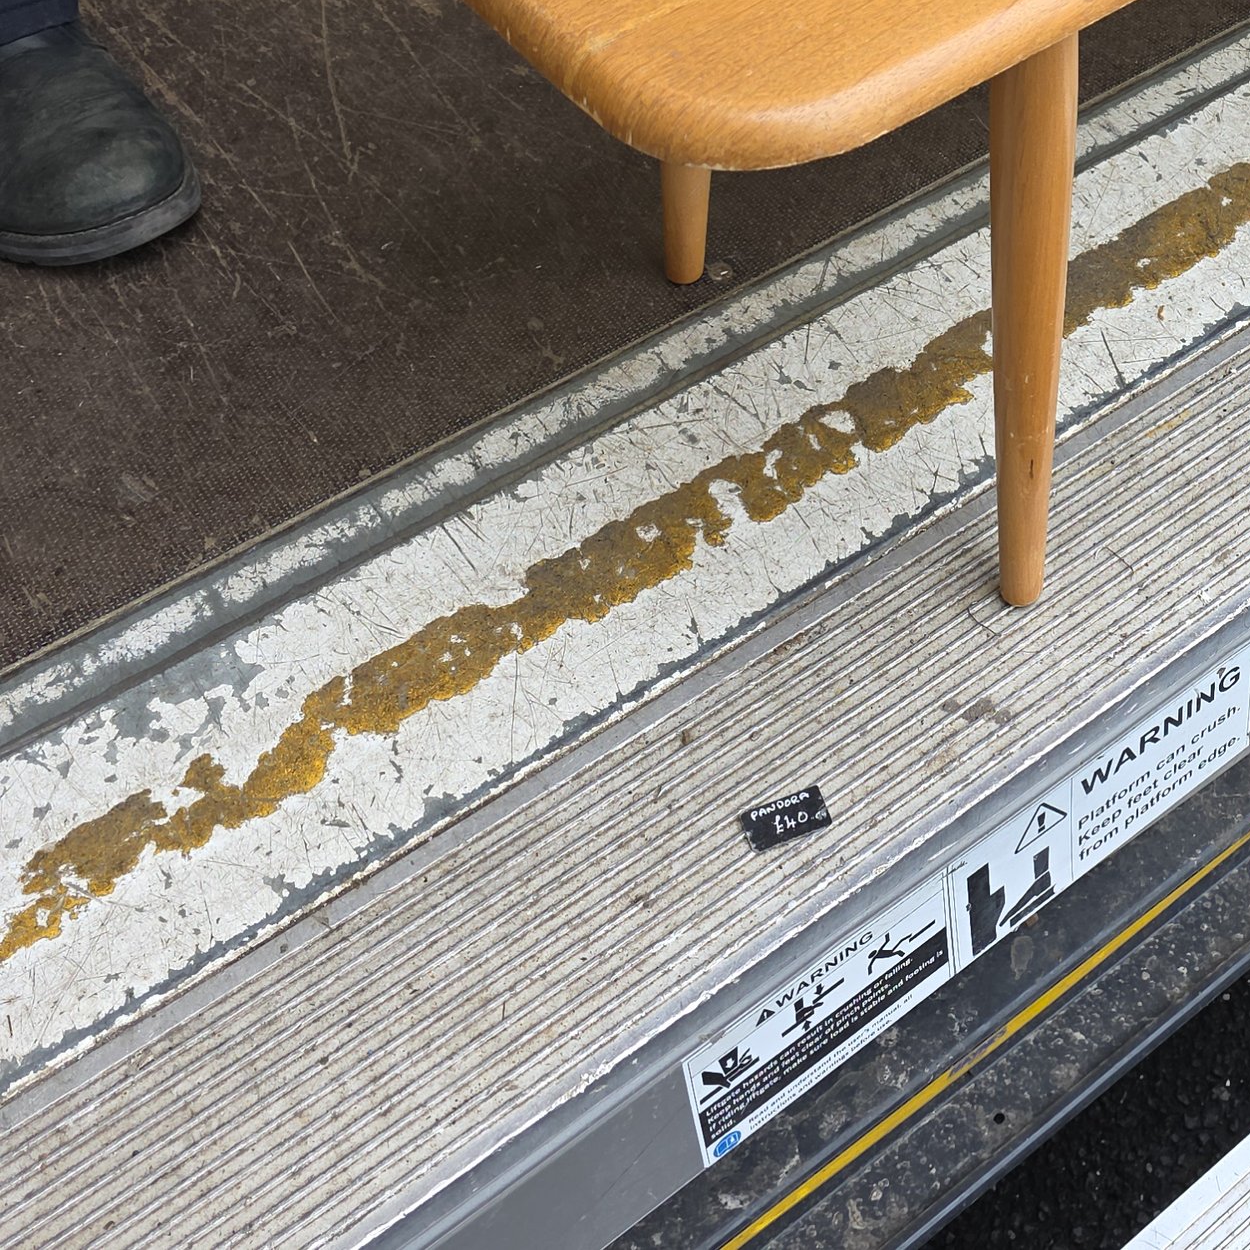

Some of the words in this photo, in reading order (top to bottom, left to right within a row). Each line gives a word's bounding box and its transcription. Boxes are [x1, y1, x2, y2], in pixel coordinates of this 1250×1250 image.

[1079, 771, 1151, 830] Platform
[1156, 744, 1186, 771] can
[1191, 706, 1241, 745] crush.
[1081, 666, 1241, 795] WARNING
[750, 791, 810, 821] PANDORA
[1079, 808, 1122, 846] Keep
[1127, 778, 1159, 808] feet
[1163, 745, 1204, 781] clear
[1079, 826, 1119, 861] from
[1125, 769, 1193, 829] platform
[1198, 737, 1241, 770] edge.
[776, 931, 873, 1008] WARNING
[706, 1087, 741, 1116] Liftgate
[742, 1059, 779, 1089] hazards
[779, 1046, 796, 1061] can
[797, 1025, 823, 1048] result
[825, 1017, 834, 1027] in
[835, 986, 873, 1019] crushing
[873, 979, 883, 989] or
[885, 958, 914, 980] falling.
[708, 1104, 732, 1125] Keep
[733, 1082, 761, 1105] hands
[763, 1065, 780, 1083] and
[781, 1051, 800, 1068] feet
[801, 1034, 824, 1053] clear
[825, 1024, 835, 1034] of
[836, 1005, 860, 1027] pinch
[862, 983, 891, 1009] points.
[709, 1123, 718, 1132] If
[718, 1100, 747, 1126] riding
[783, 1054, 808, 1075] make
[809, 1037, 829, 1055] sure
[830, 1021, 849, 1039] load
[851, 1015, 859, 1024] is
[860, 994, 886, 1017] stable
[887, 979, 904, 996] and
[905, 956, 935, 981] footing
[936, 949, 944, 958] is
[711, 1119, 737, 1139] solid.
